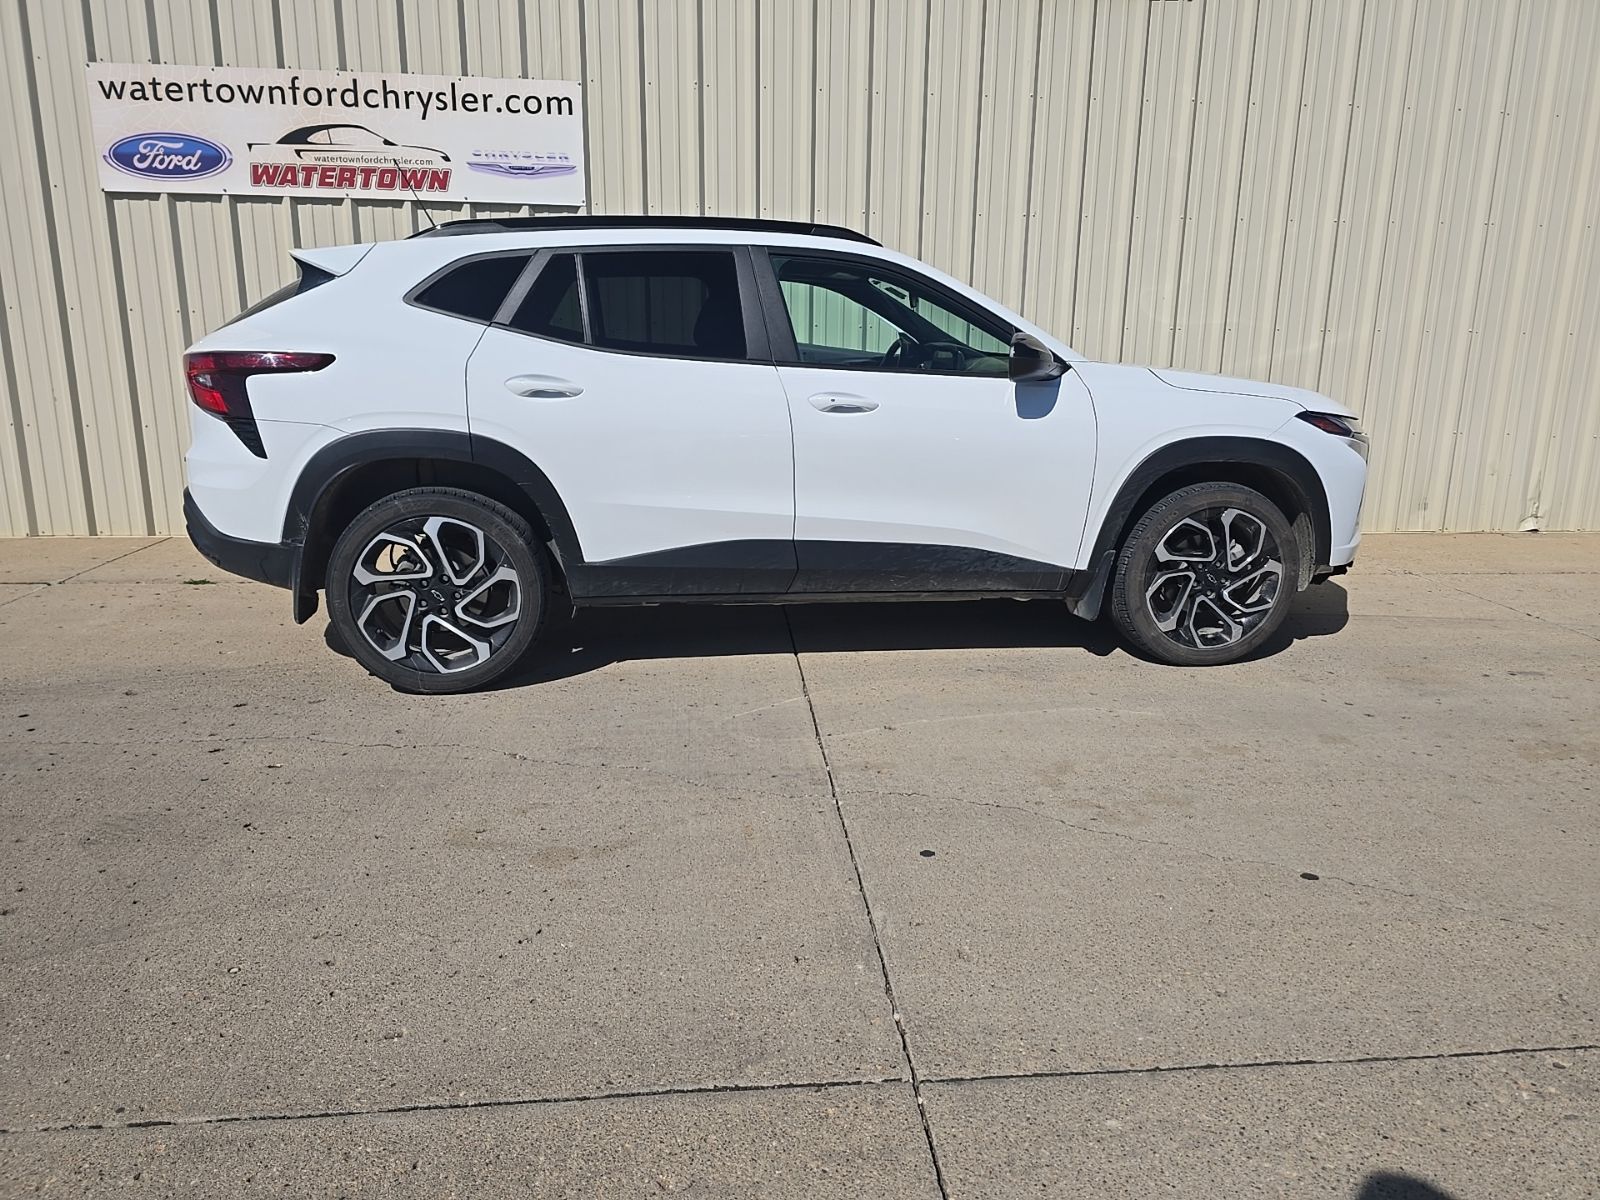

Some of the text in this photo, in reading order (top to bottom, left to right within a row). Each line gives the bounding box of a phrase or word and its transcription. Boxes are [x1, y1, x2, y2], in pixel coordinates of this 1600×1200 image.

[97, 76, 573, 120] watertownfordchrysler.com
[132, 139, 202, 171] Ford
[250, 162, 452, 192] WATERTOWN
